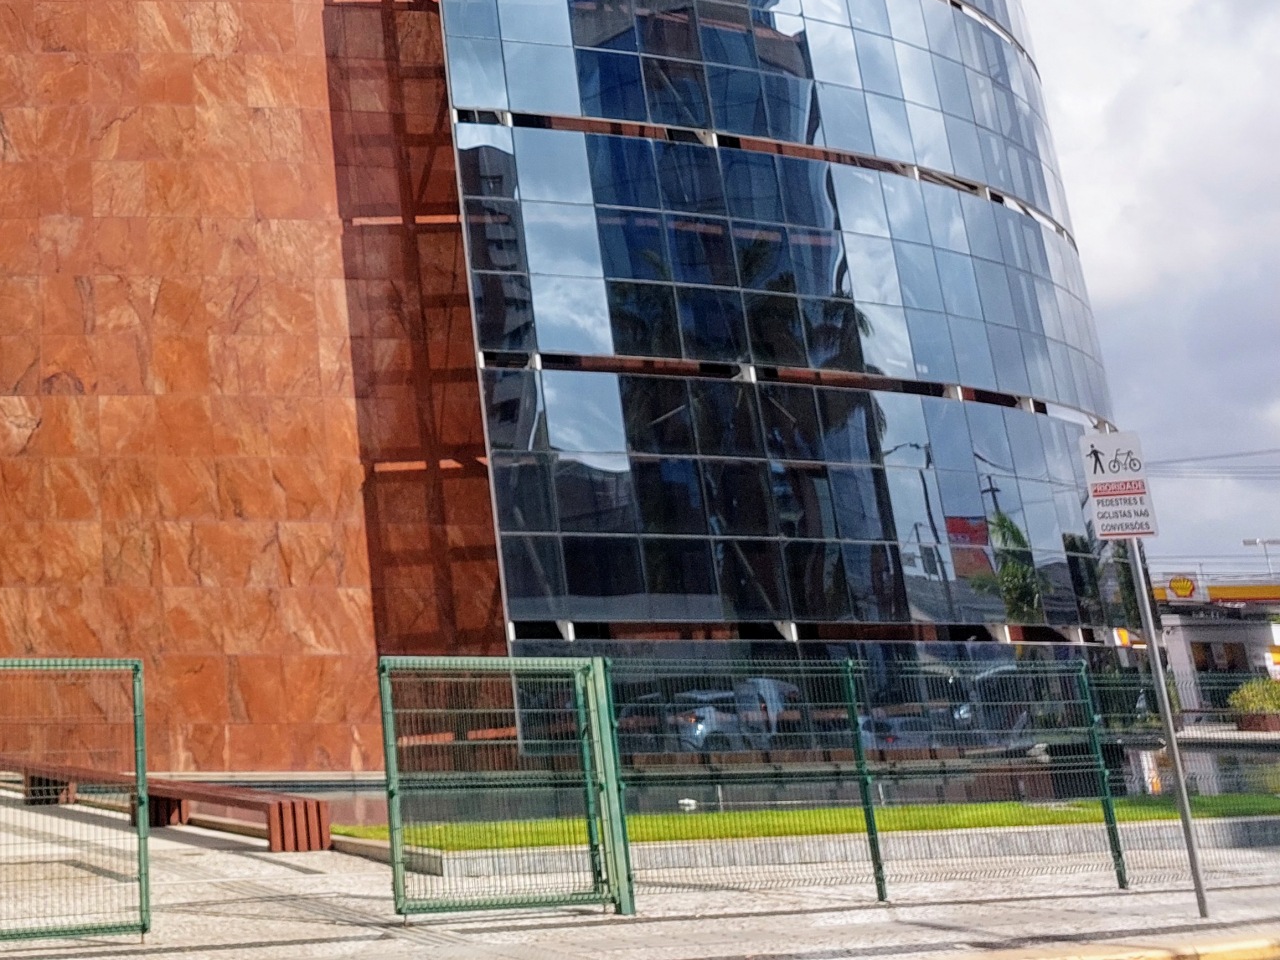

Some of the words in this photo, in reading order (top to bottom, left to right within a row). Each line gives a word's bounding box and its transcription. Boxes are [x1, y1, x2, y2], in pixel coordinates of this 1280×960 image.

[1094, 481, 1145, 493] PRIORIDADE
[1096, 497, 1138, 507] PEDESTRES
[1139, 496, 1145, 506] E
[1097, 510, 1132, 520] CICLISTAS
[1133, 509, 1150, 518] NAS
[1100, 521, 1151, 532] CONVERSÕES
